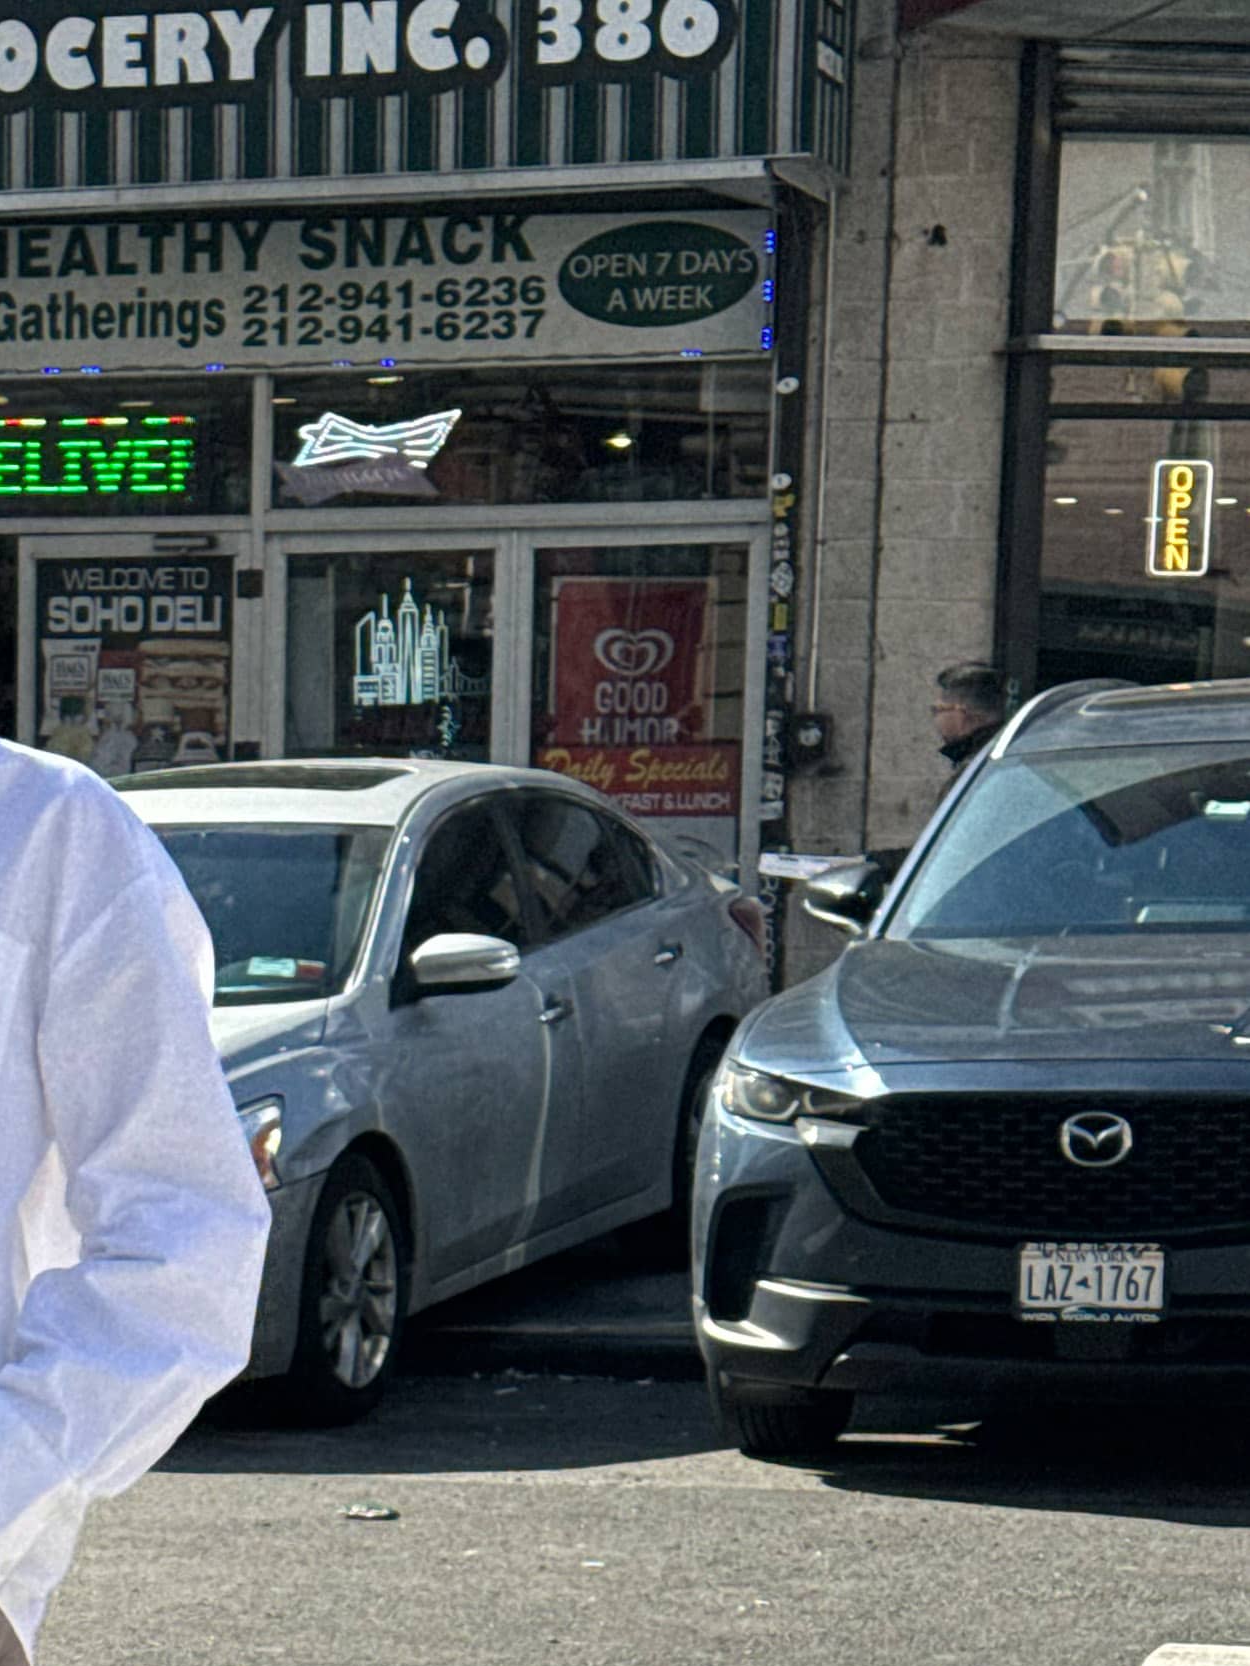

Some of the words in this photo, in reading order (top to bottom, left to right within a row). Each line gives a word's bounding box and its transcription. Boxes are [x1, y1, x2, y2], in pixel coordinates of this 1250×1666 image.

[305, 0, 491, 77] INC.
[298, 215, 535, 271] SNACK
[568, 252, 647, 279] OPEN
[655, 252, 672, 277] 7
[680, 248, 753, 276] DAYS
[242, 274, 547, 314] 212-941-6236
[606, 287, 628, 313] A
[632, 284, 714, 311] WEEK
[242, 308, 547, 347] 212-941-6237
[1164, 465, 1194, 571] OPEN
[62, 567, 175, 591] WELCOME
[181, 566, 209, 590] TO
[48, 595, 144, 633] SOHO
[150, 594, 223, 632] DELI
[594, 680, 669, 715] GOOD
[579, 716, 681, 744] HUMOR
[544, 749, 616, 788] Daily
[625, 748, 730, 787] Specials
[677, 792, 731, 811] LUNCH
[1027, 1263, 1075, 1302] LAZ
[1094, 1264, 1157, 1302] 1767
